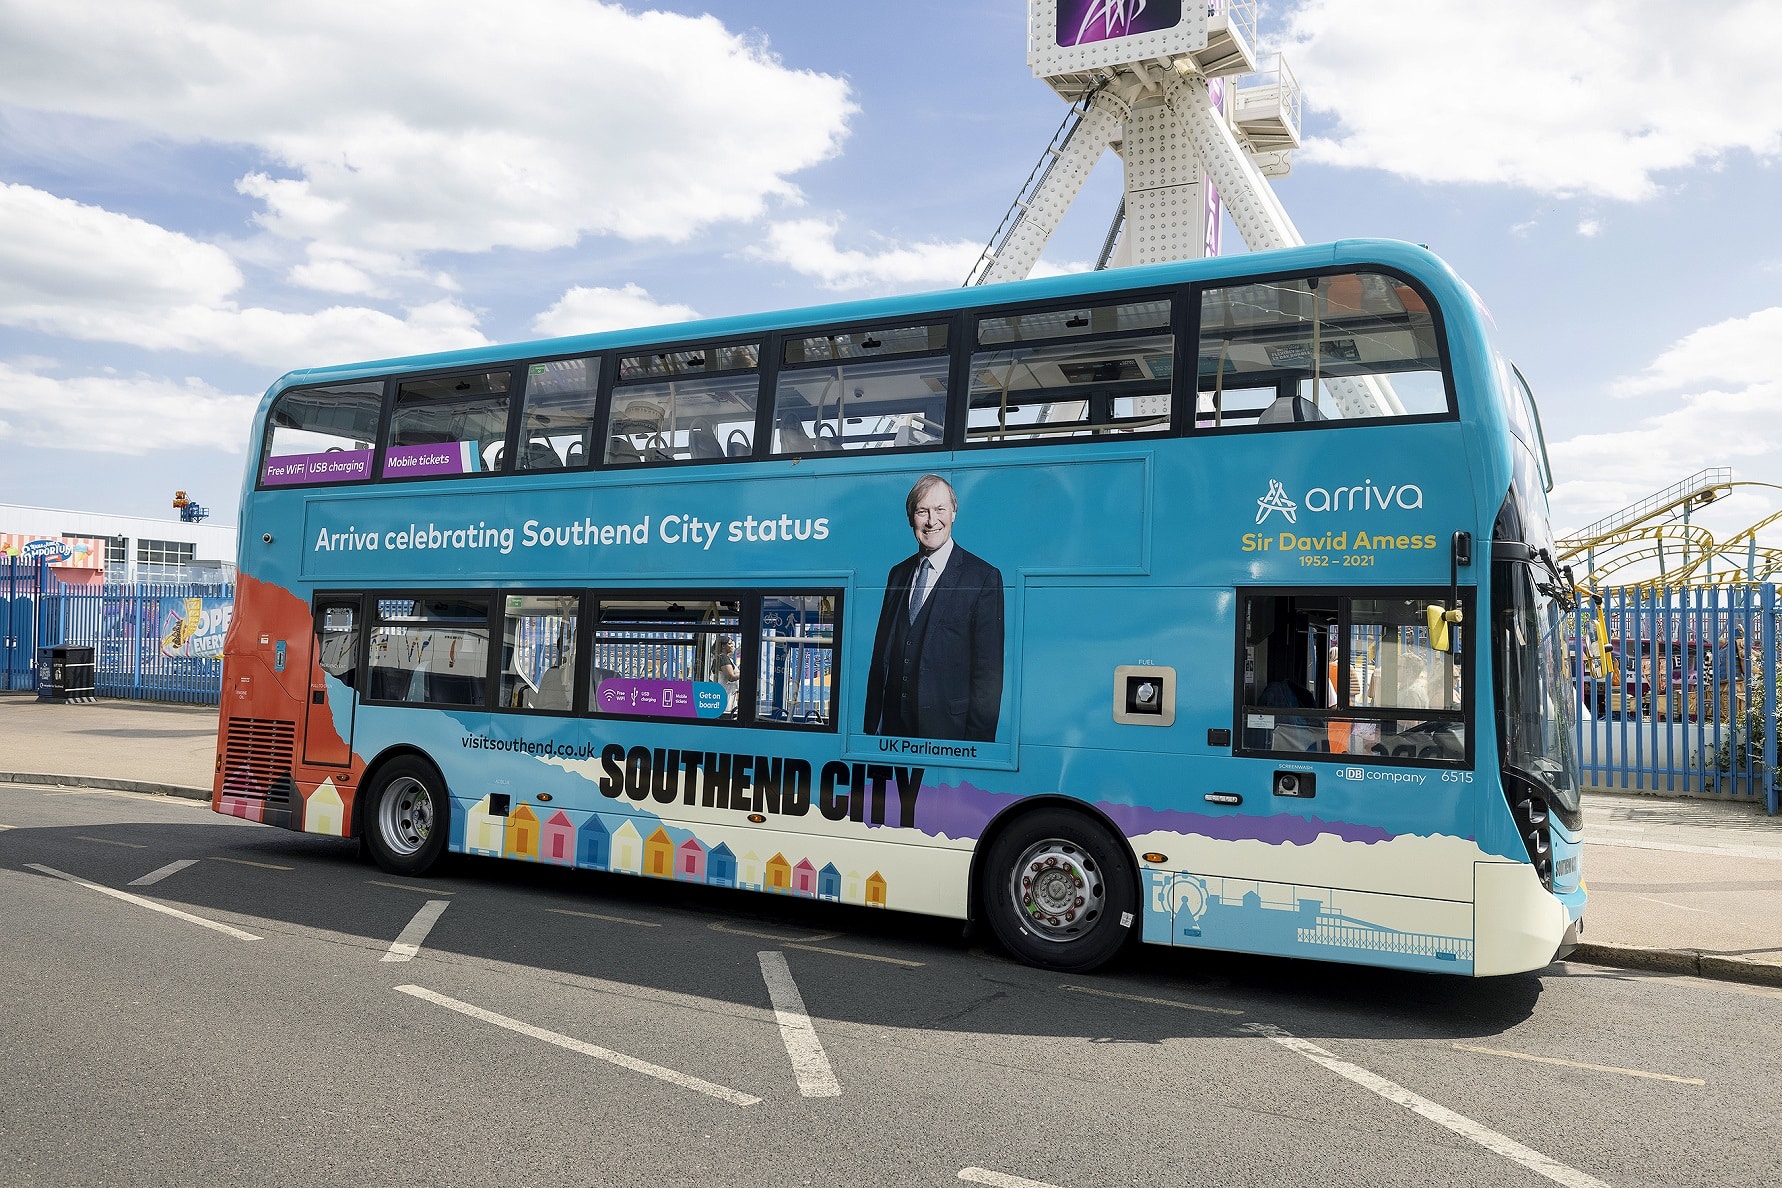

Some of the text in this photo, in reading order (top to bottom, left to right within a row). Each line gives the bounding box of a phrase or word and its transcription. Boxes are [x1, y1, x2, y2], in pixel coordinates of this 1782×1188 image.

[309, 460, 364, 474] USB charging
[388, 454, 450, 468] Mobile tickets
[267, 463, 304, 476] Free WiFi
[1305, 479, 1423, 512] arriva
[315, 513, 830, 555] Arriva celebrating Southend City status
[1241, 531, 1437, 552] Sir David Amess
[1299, 555, 1329, 567] 1952
[1343, 555, 1375, 567] 2021
[699, 691, 712, 700] Get
[699, 700, 720, 709] board!
[461, 733, 596, 758] visitsouthend.co.uk
[878, 739, 978, 758] UK Parliament
[1335, 770, 1344, 778] a
[1366, 769, 1427, 785] company
[1441, 770, 1474, 784] 6515
[599, 743, 926, 828] SOUTHEND CITY
